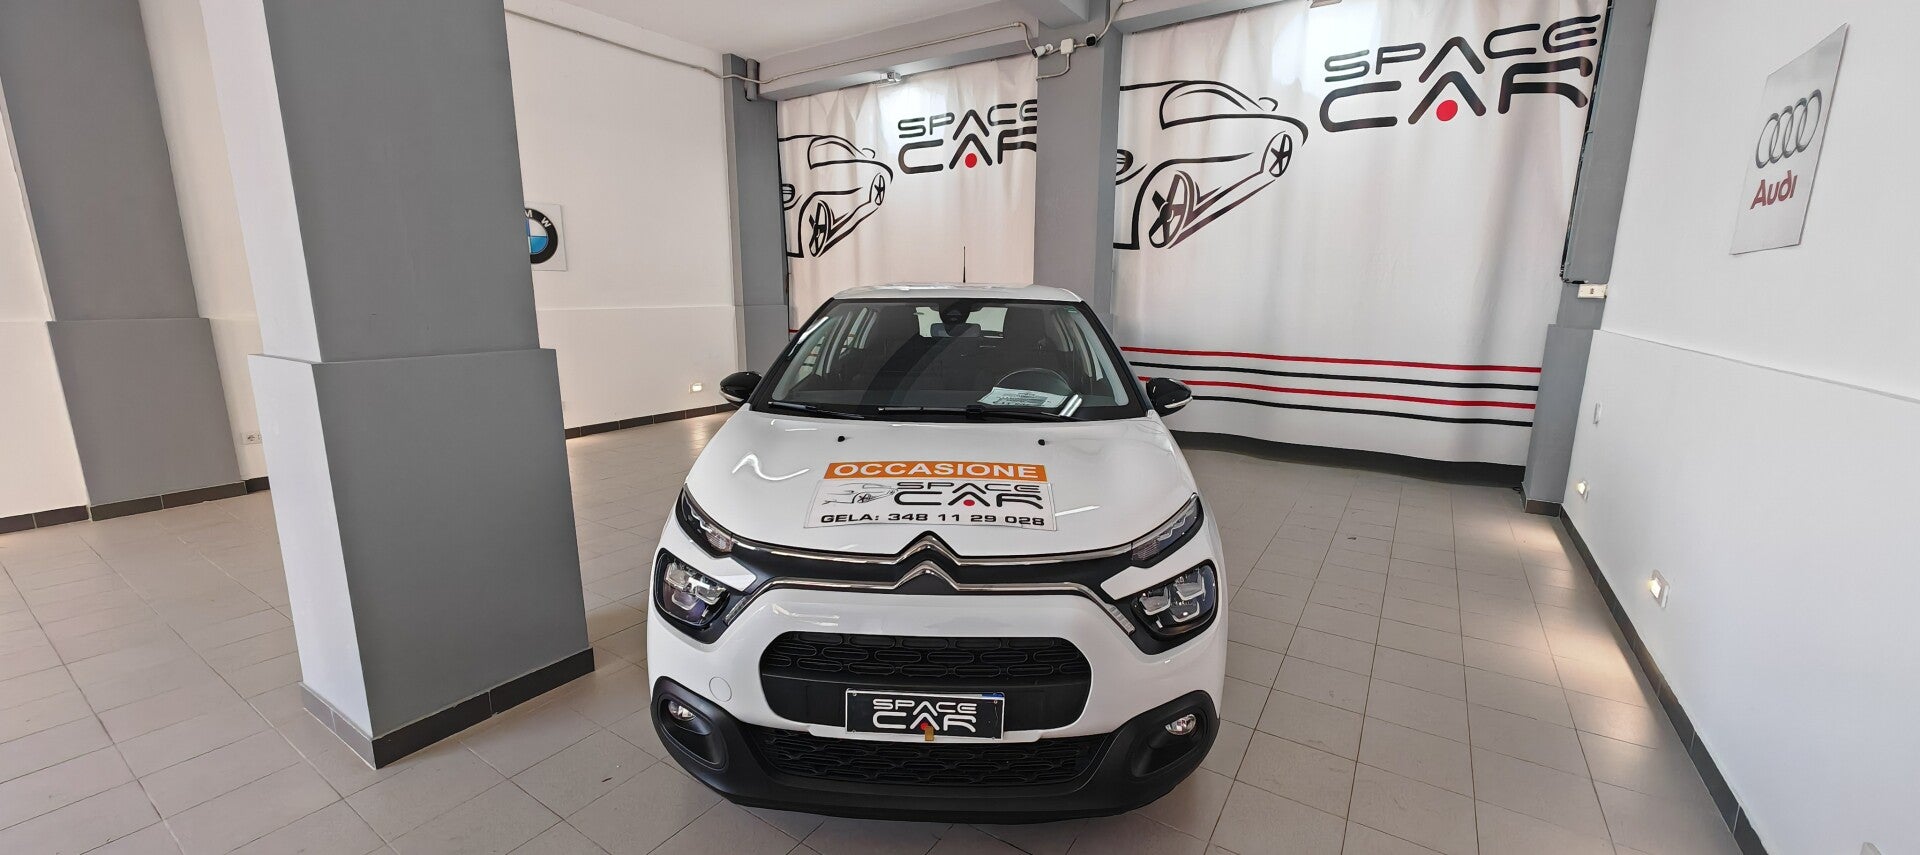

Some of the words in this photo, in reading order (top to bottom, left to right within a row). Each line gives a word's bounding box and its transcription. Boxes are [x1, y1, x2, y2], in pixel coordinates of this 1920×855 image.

[1324, 14, 1601, 83] SPACE
[1319, 56, 1593, 132] CAR
[1750, 170, 1798, 210] Audi
[833, 463, 1039, 479] OCCASIONE
[896, 481, 1041, 494] SPACE
[894, 490, 1043, 509] CAR
[821, 514, 880, 523] GELA:
[888, 513, 928, 521] 348
[937, 513, 959, 522] 11
[970, 514, 997, 523] 29
[1004, 515, 1045, 526] 028
[872, 699, 978, 717] SPACE
[872, 711, 977, 733] CAR
